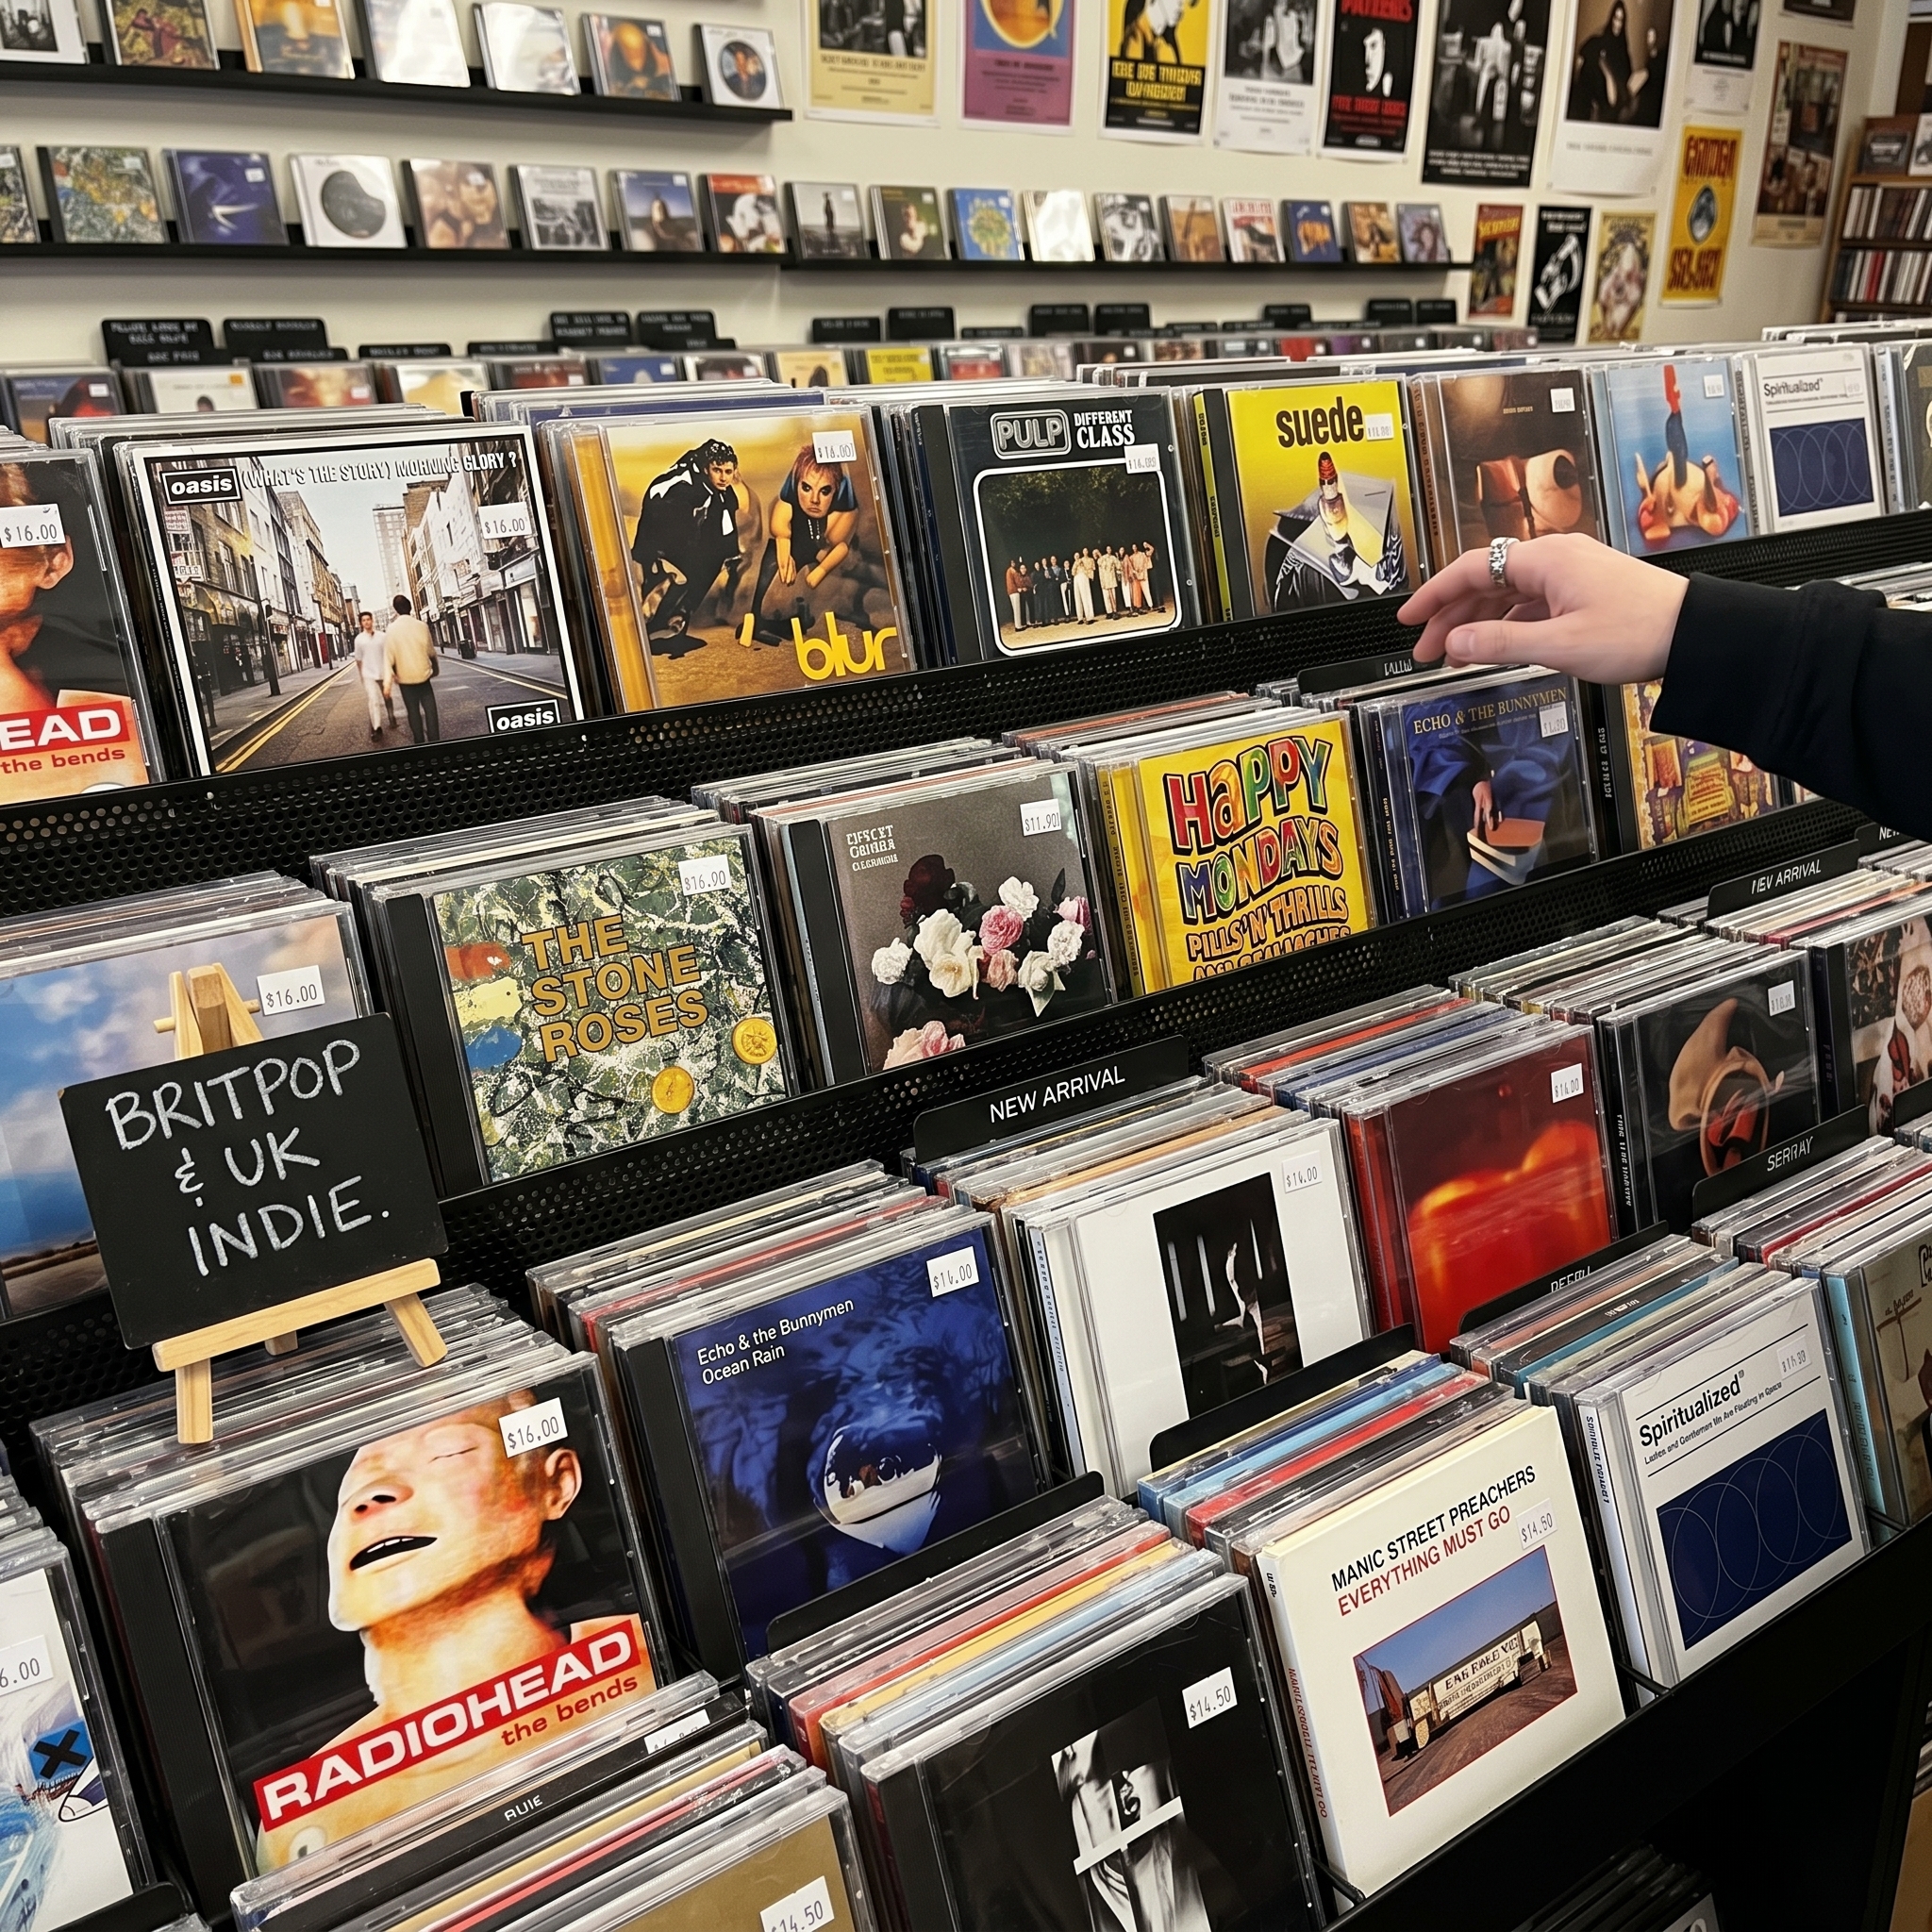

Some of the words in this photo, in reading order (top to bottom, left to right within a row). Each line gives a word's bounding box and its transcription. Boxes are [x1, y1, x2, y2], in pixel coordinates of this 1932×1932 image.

[997, 417, 1063, 450] PULP
[1074, 409, 1133, 426] DIFFERENT
[1076, 424, 1135, 449] CLASS
[1275, 396, 1364, 448] suede
[171, 475, 233, 495] oasis
[309, 466, 337, 484] THE
[341, 464, 391, 482] STORY)
[396, 456, 459, 478] MORNING
[460, 452, 504, 472] GLORY
[508, 451, 517, 469] ?
[4, 523, 58, 543] $16.00
[484, 517, 526, 535] $16.00
[791, 611, 898, 680] blur
[496, 708, 555, 731] oasis
[1413, 713, 1451, 735] ECHO
[1468, 704, 1496, 722] THE
[0, 757, 42, 775] the
[51, 747, 125, 769] bends
[1175, 815, 1343, 925] MONDAYS
[1775, 859, 1822, 887] ARRIVAL
[521, 913, 629, 972] THE
[265, 983, 318, 1008] $16.00
[531, 943, 702, 1018] STONE
[539, 989, 708, 1064] ROSES
[105, 1039, 361, 1151] BRITPOP
[990, 1090, 1038, 1124] NEW
[1042, 1065, 1126, 1108] ARRIVAL
[175, 1146, 204, 1208] &
[224, 1127, 321, 1188] UK
[697, 1341, 735, 1366] Echo
[738, 1334, 751, 1351] &
[753, 1326, 776, 1345] the
[779, 1298, 855, 1337] Bunnymen
[702, 1357, 750, 1386] Ocean
[754, 1344, 786, 1368] Rain
[508, 1417, 560, 1450] $16.00
[1331, 1549, 1385, 1591] MANIC
[1388, 1513, 1447, 1559] STREET
[1449, 1465, 1537, 1522] PREACHERS
[1338, 1545, 1441, 1617] EVERYTHING
[1443, 1519, 1485, 1558] MUST
[1489, 1504, 1511, 1531] GO
[501, 1716, 548, 1747] the
[557, 1674, 638, 1722] bends
[1189, 1684, 1232, 1722] $14.50
[262, 1630, 632, 1821] RADIOHEAD
[772, 1900, 824, 1932] 14.50
